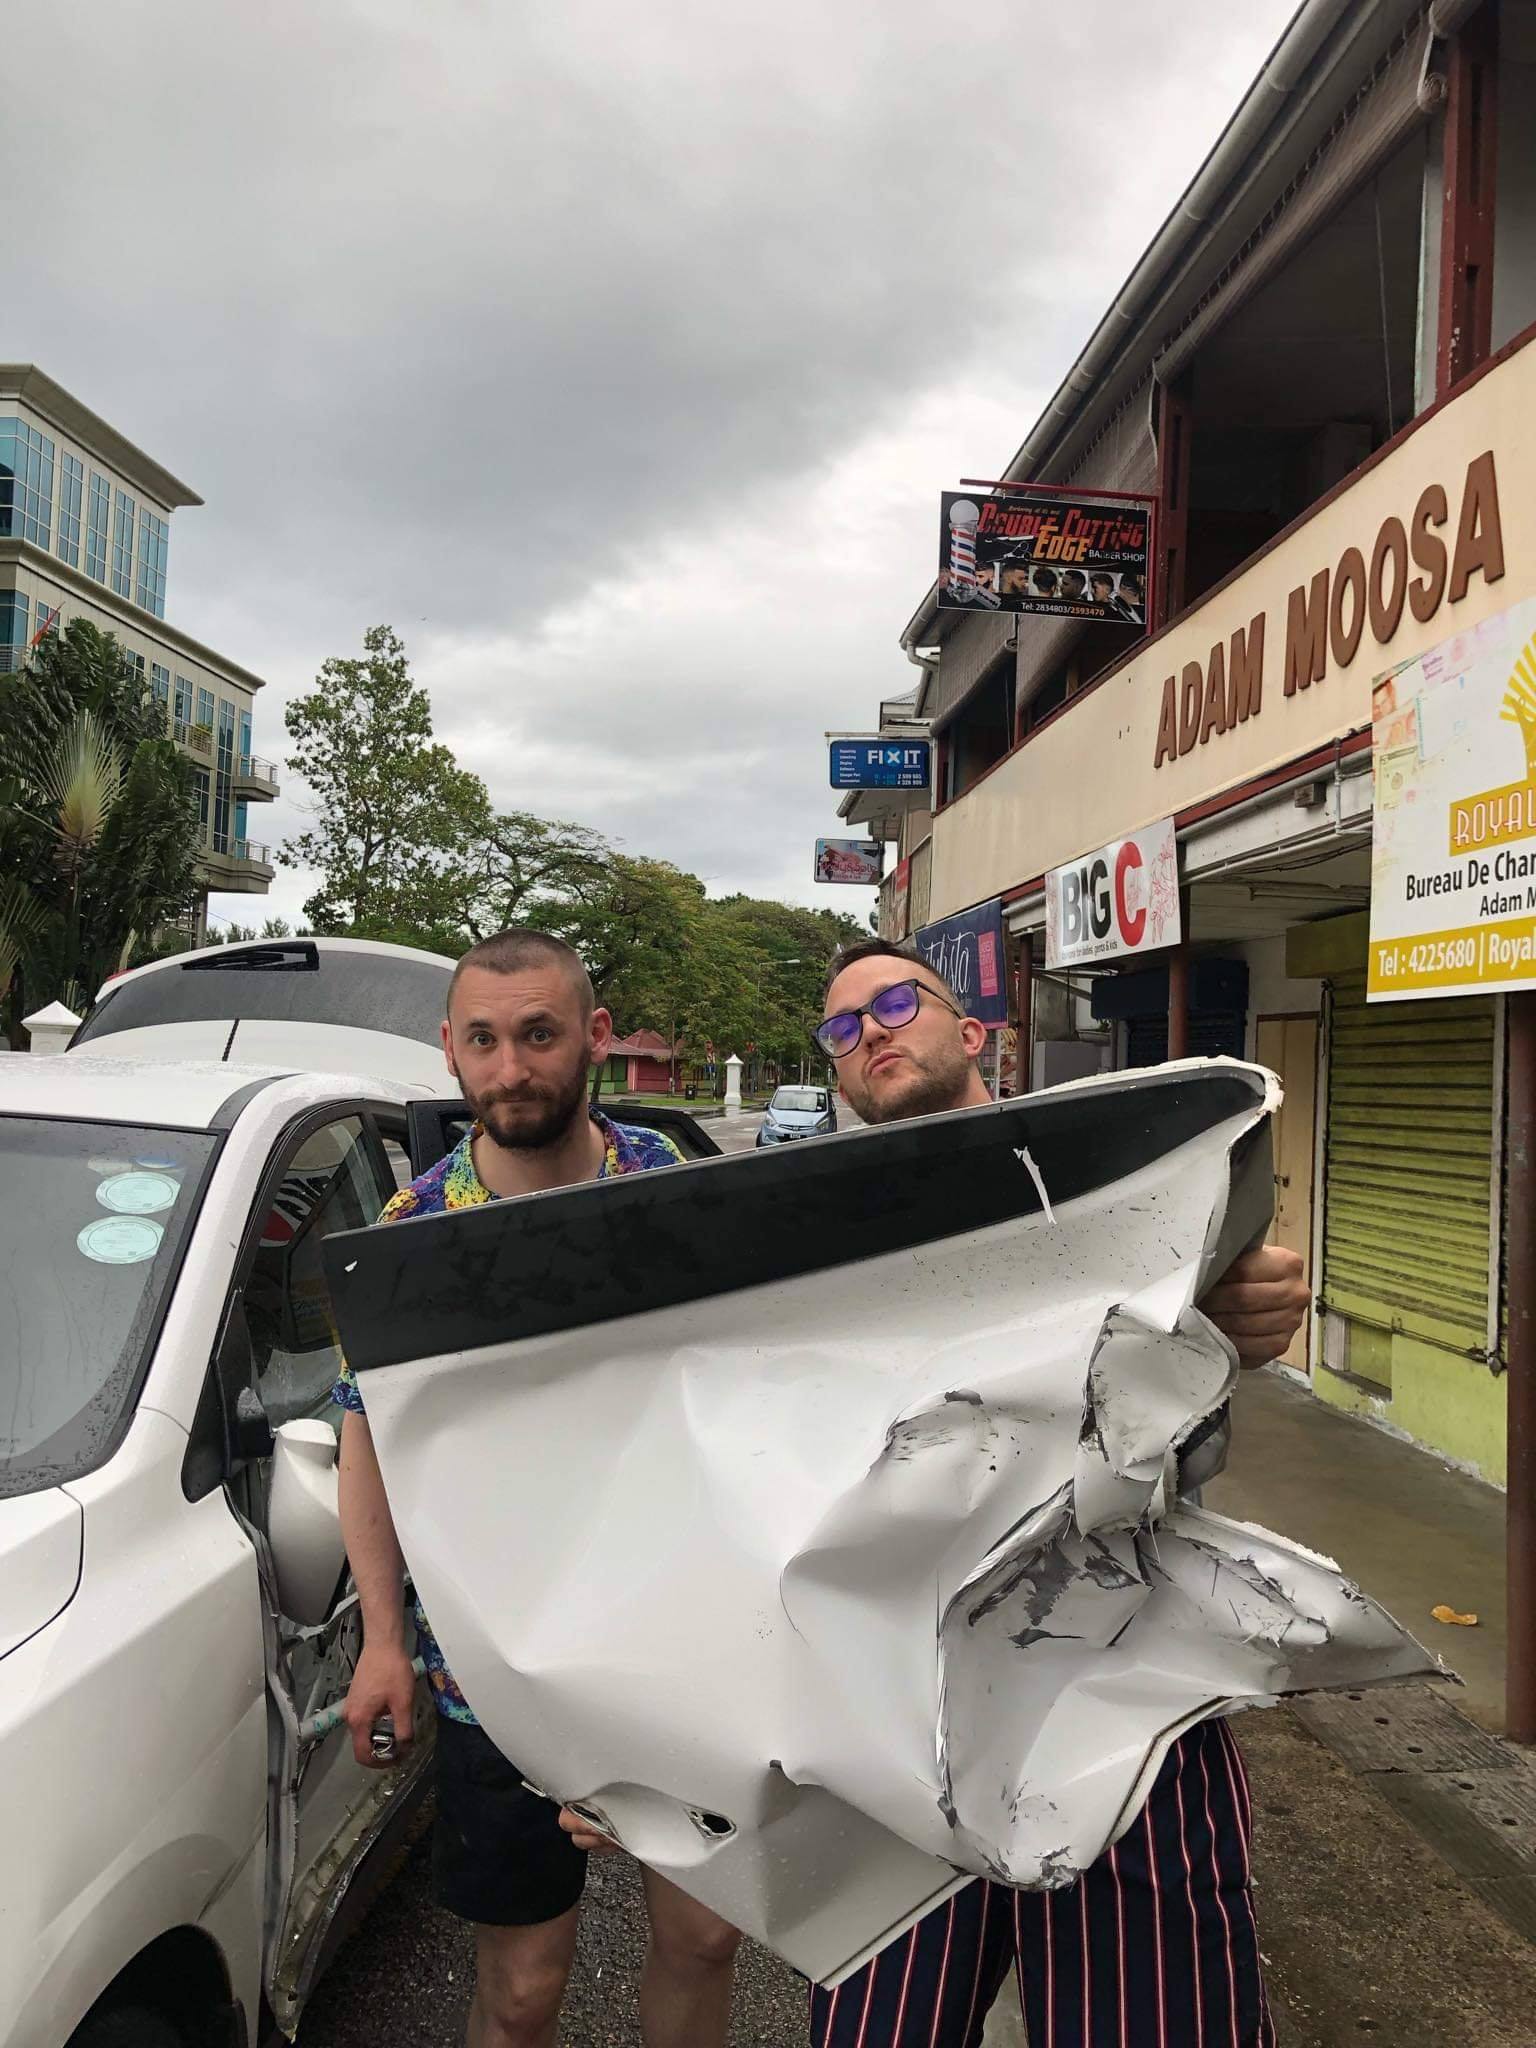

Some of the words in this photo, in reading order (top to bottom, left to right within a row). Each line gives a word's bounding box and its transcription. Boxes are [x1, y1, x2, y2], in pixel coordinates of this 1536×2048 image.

[1033, 525, 1090, 561] EDGE
[1122, 552, 1146, 562] SHOP
[1154, 612, 1265, 768] ADAM
[1283, 450, 1505, 696] MOOSA
[1062, 859, 1112, 947] BIG
[1114, 841, 1147, 947] C
[1406, 870, 1463, 901] Bureau
[1467, 859, 1490, 888] De
[1480, 892, 1522, 917] Adam
[1408, 937, 1476, 974] 4225680
[1488, 926, 1536, 971] Royal
